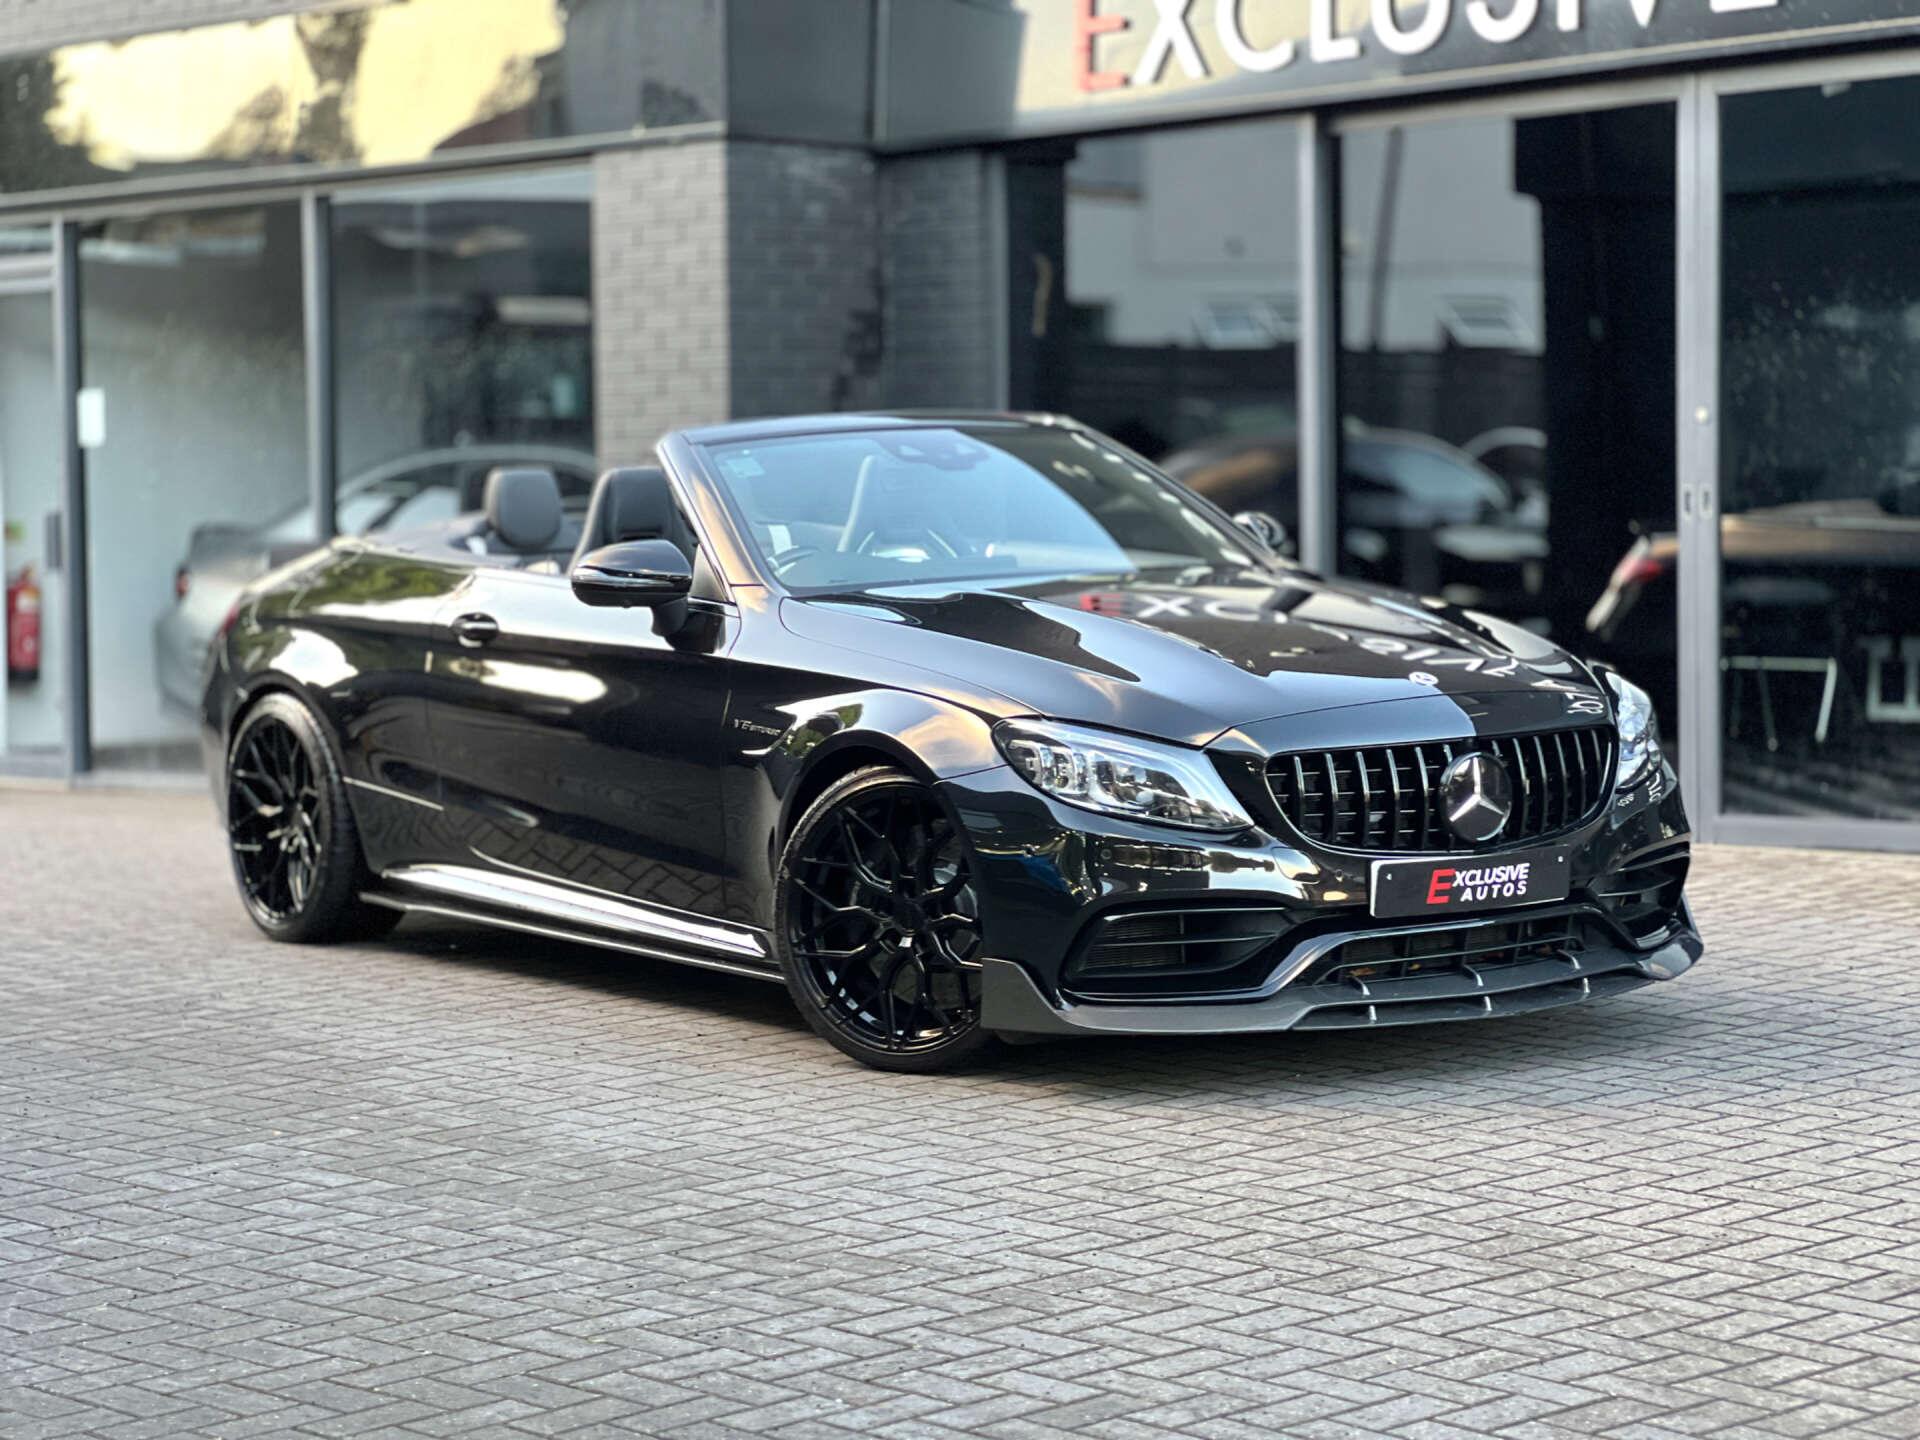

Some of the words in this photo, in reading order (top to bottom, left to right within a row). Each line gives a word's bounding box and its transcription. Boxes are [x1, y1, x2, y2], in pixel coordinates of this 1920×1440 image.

[1075, 0, 1780, 93] EXCLU
[1426, 862, 1531, 905] EXCLUSIVE
[1460, 880, 1528, 902] AUTOS
